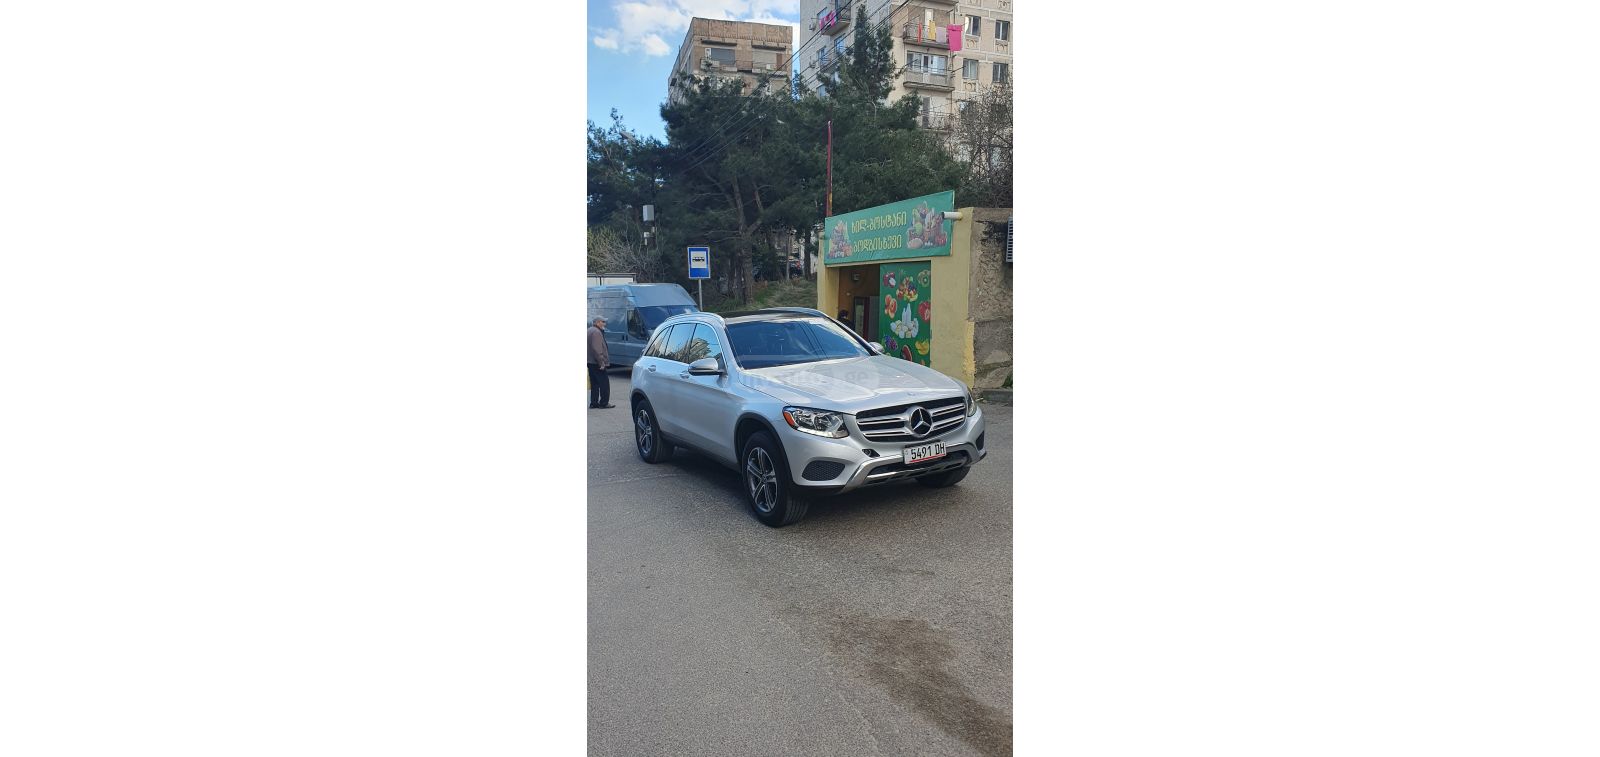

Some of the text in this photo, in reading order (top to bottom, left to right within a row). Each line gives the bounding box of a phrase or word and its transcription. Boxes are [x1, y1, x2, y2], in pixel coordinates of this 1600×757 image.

[851, 211, 907, 234] ხილ-ბოსტანი
[910, 442, 945, 459] 5491 DH
